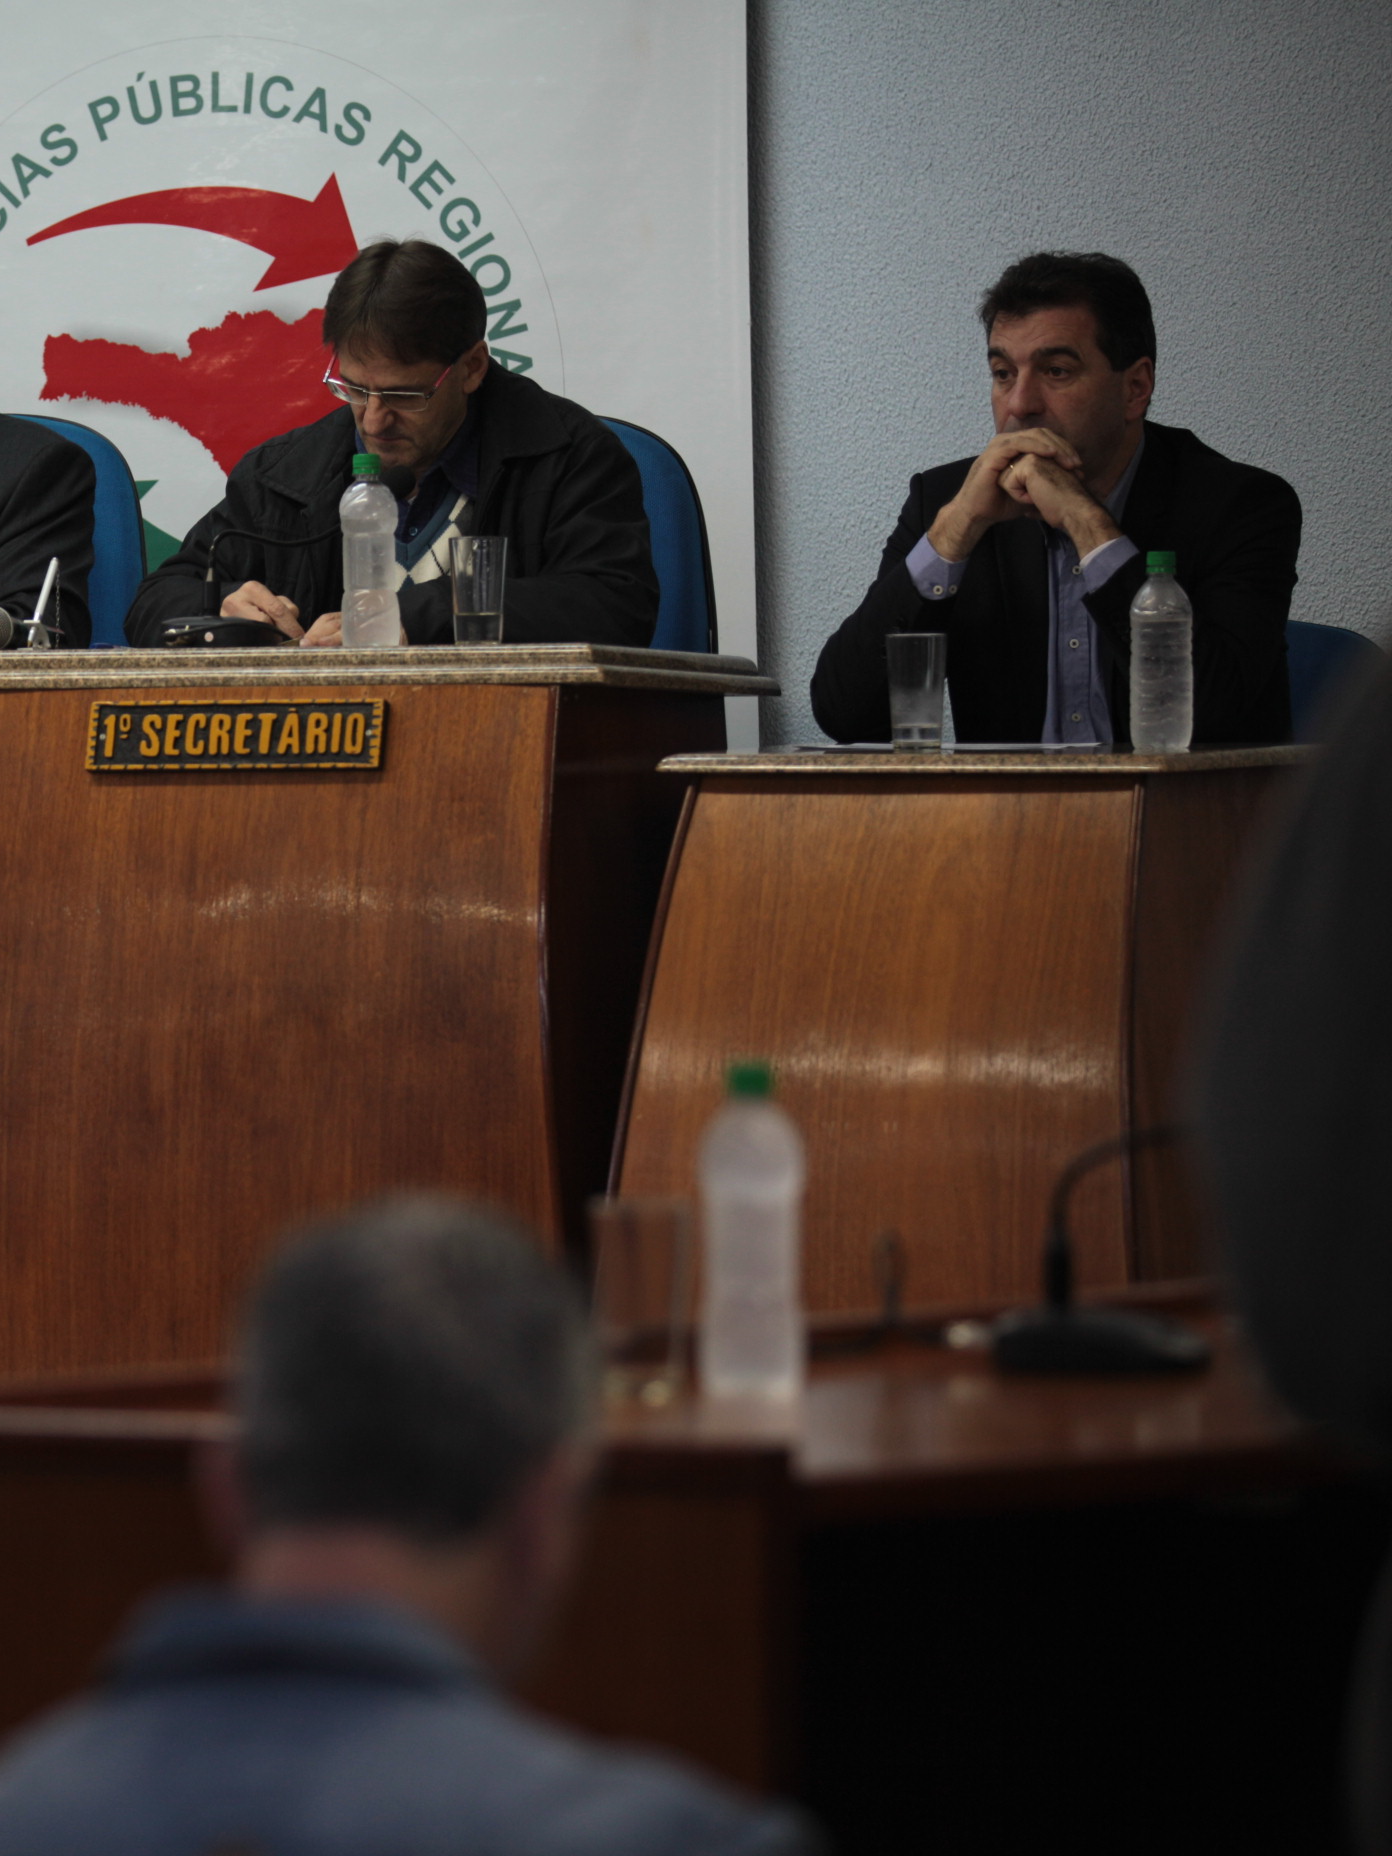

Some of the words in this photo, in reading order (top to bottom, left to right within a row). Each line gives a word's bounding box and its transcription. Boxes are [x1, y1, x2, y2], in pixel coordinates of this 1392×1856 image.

[87, 70, 373, 146] PÚBLICAS
[377, 129, 534, 375] REGIONA
[139, 707, 366, 758] SECRETÁRIO
